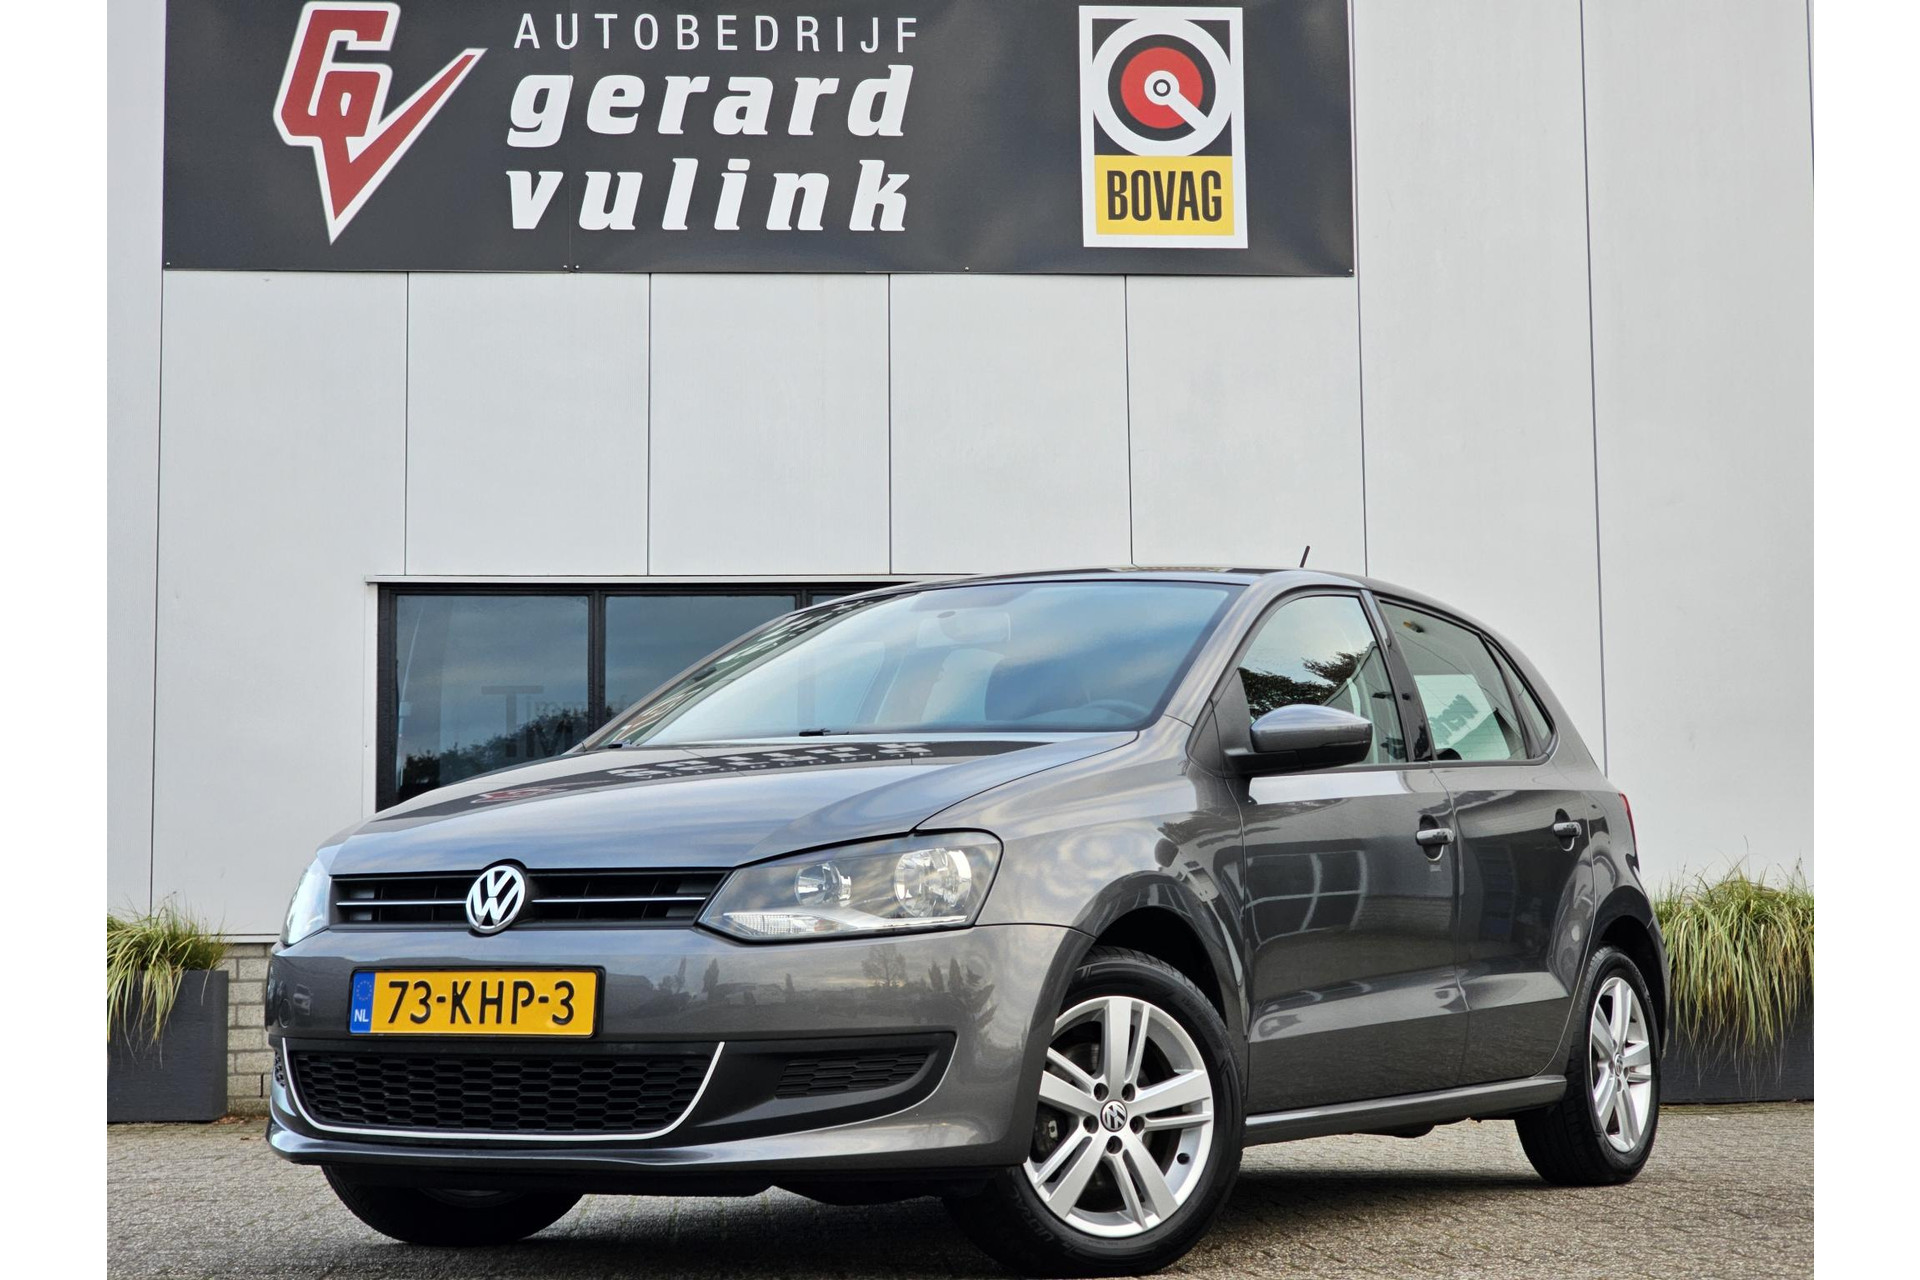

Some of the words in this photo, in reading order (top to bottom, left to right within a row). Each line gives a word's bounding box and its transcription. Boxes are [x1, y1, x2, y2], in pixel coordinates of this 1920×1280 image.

[514, 13, 917, 53] AUTOBEDRIJF
[507, 65, 914, 147] gerard
[506, 158, 910, 231] vulink
[1106, 169, 1223, 222] BOVAG
[354, 1009, 369, 1023] NL
[388, 980, 575, 1026] 73-KHP-3
